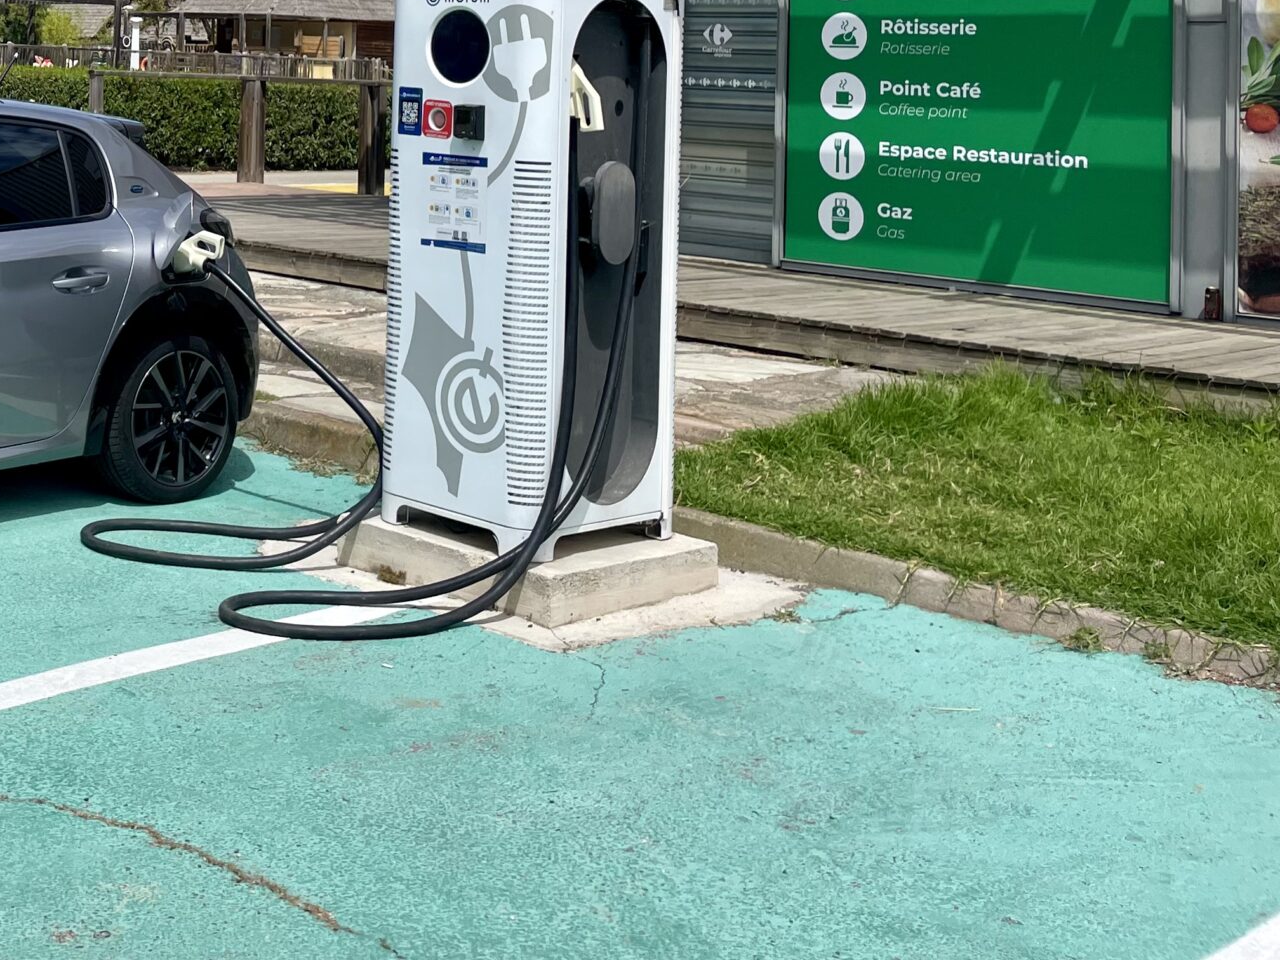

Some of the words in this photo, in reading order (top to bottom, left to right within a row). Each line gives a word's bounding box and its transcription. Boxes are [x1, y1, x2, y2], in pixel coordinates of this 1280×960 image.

[880, 18, 977, 36] Rôtisserie
[880, 41, 950, 56] Rotisserie
[879, 79, 931, 97] Point
[936, 81, 982, 99] Café
[878, 102, 925, 117] Coffee
[927, 104, 968, 120] point
[878, 141, 947, 161] Espace
[952, 145, 1089, 169] Restauration
[877, 163, 941, 183] Catering
[944, 170, 981, 183] area
[876, 202, 913, 220] Gaz
[876, 224, 905, 240] Gas
